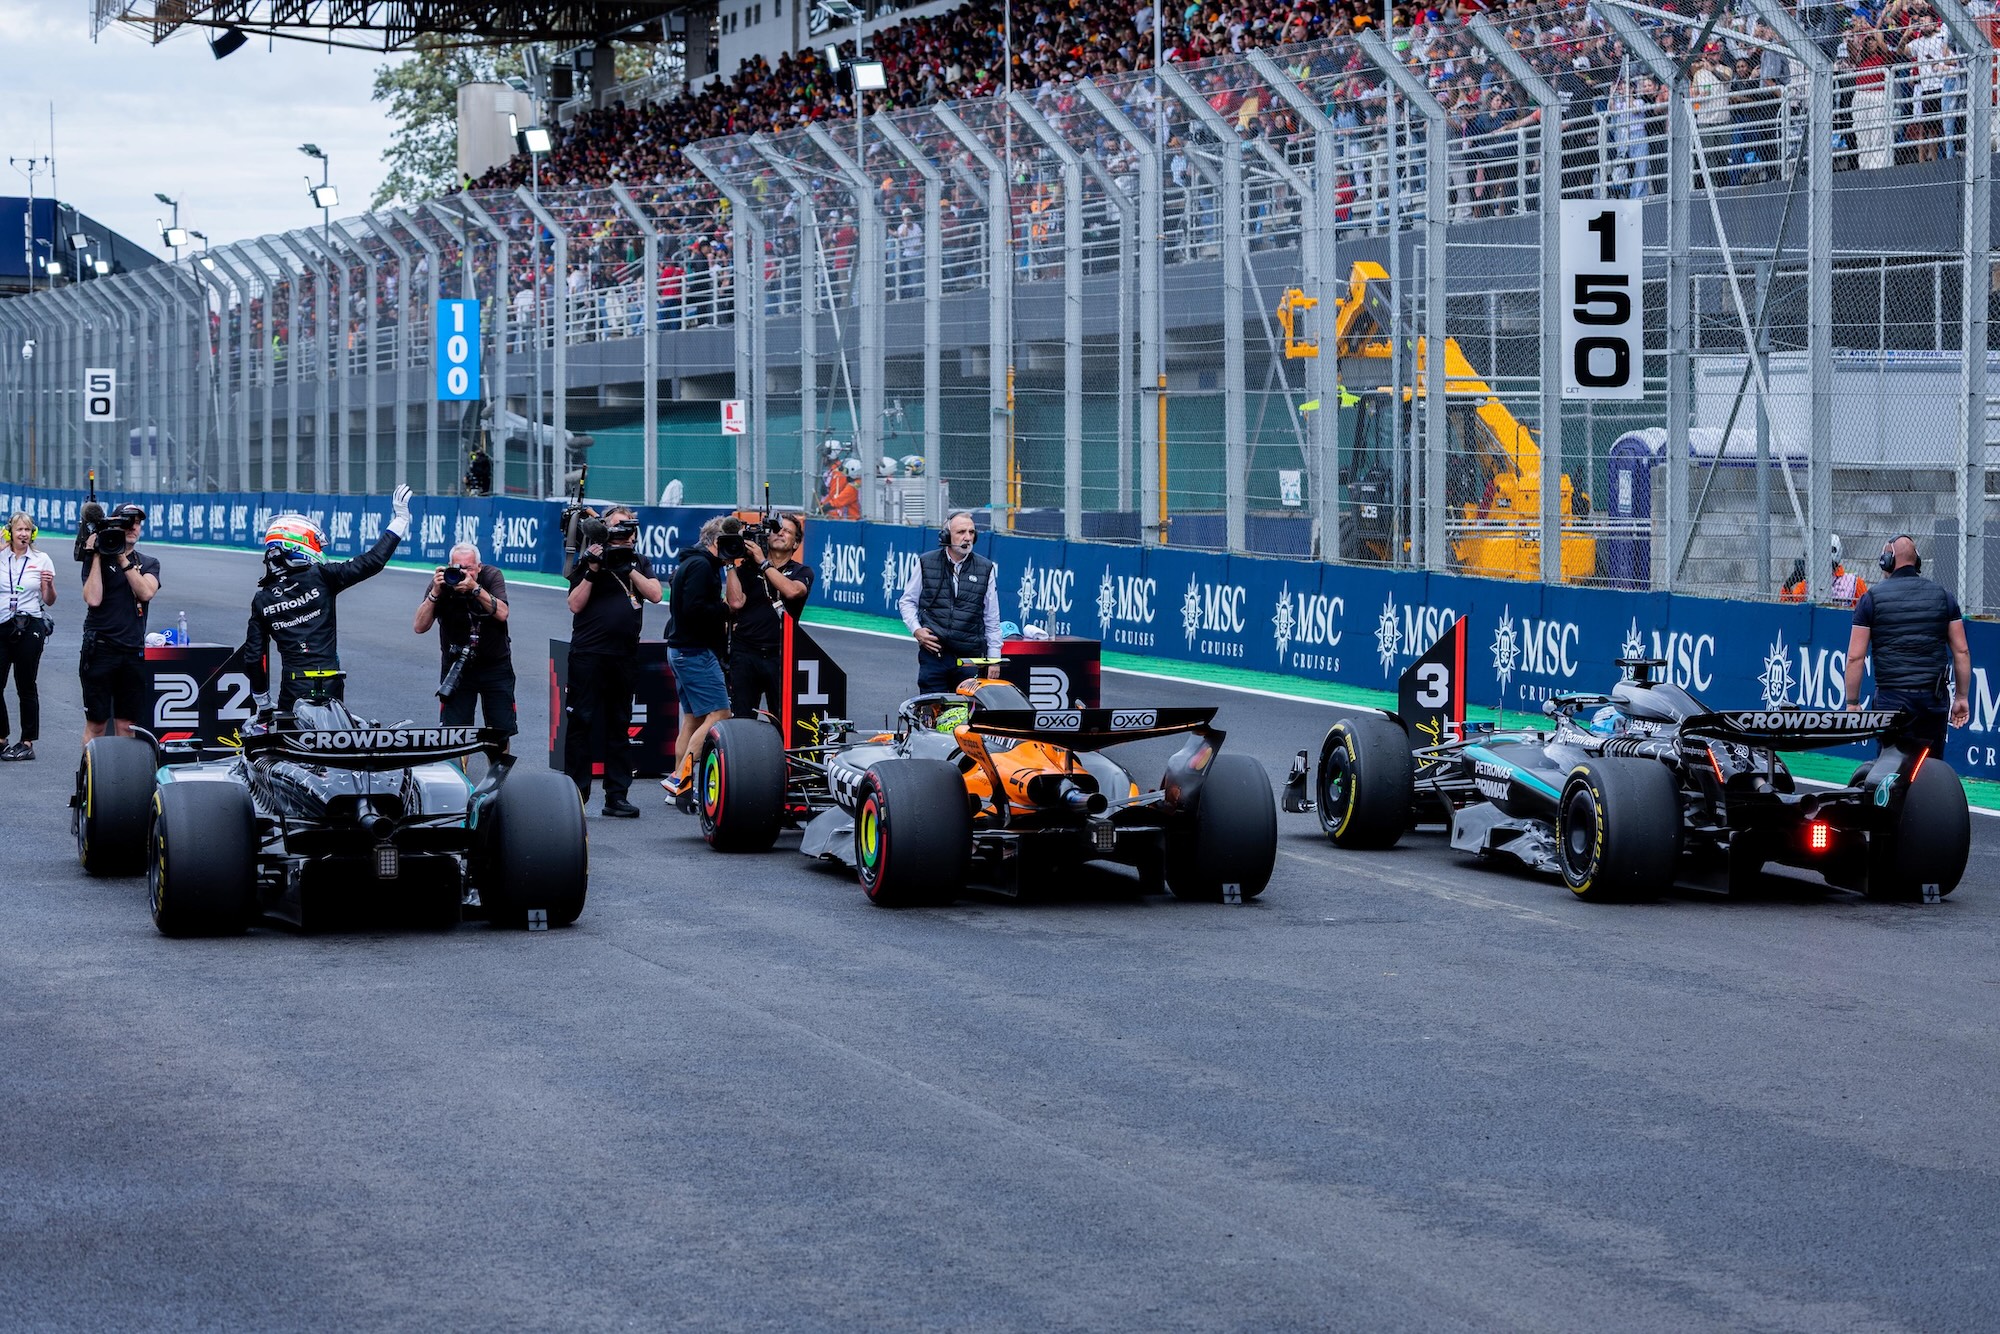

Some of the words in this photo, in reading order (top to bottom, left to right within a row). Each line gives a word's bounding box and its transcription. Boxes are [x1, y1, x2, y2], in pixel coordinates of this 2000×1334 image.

[1573, 211, 1631, 388] 150
[447, 303, 468, 396] 100
[90, 374, 111, 416] 50
[428, 515, 446, 544] MSC
[1361, 506, 1377, 518] JCB
[506, 517, 538, 548] MSC
[635, 524, 679, 559] MSC
[505, 552, 537, 563] CRUISES
[835, 543, 866, 585] MSC
[896, 551, 921, 591] MS
[263, 588, 320, 617] PETRONAS
[833, 589, 865, 604] CRUISES
[1036, 568, 1074, 613] MSC
[1116, 575, 1156, 624] MSC
[1203, 584, 1246, 633] MSC
[1295, 593, 1344, 646] MSC
[1115, 629, 1155, 646] CRUISES
[1201, 640, 1244, 658] CRUISES
[1520, 618, 1579, 677] MSC
[1293, 652, 1341, 672] CRUISES
[1651, 631, 1715, 692] MSC
[217, 672, 251, 720] 2
[797, 659, 829, 704] 1
[1416, 663, 1449, 708] 3
[1520, 684, 1577, 702] CRUIS
[153, 673, 200, 728] 2
[1036, 714, 1079, 729] OXXO
[1113, 713, 1155, 729] OXXO
[1738, 712, 1896, 730] CROWDSTRIKE
[299, 728, 480, 750] CROWDSTRIKE
[1475, 760, 1513, 780] PETRONAS
